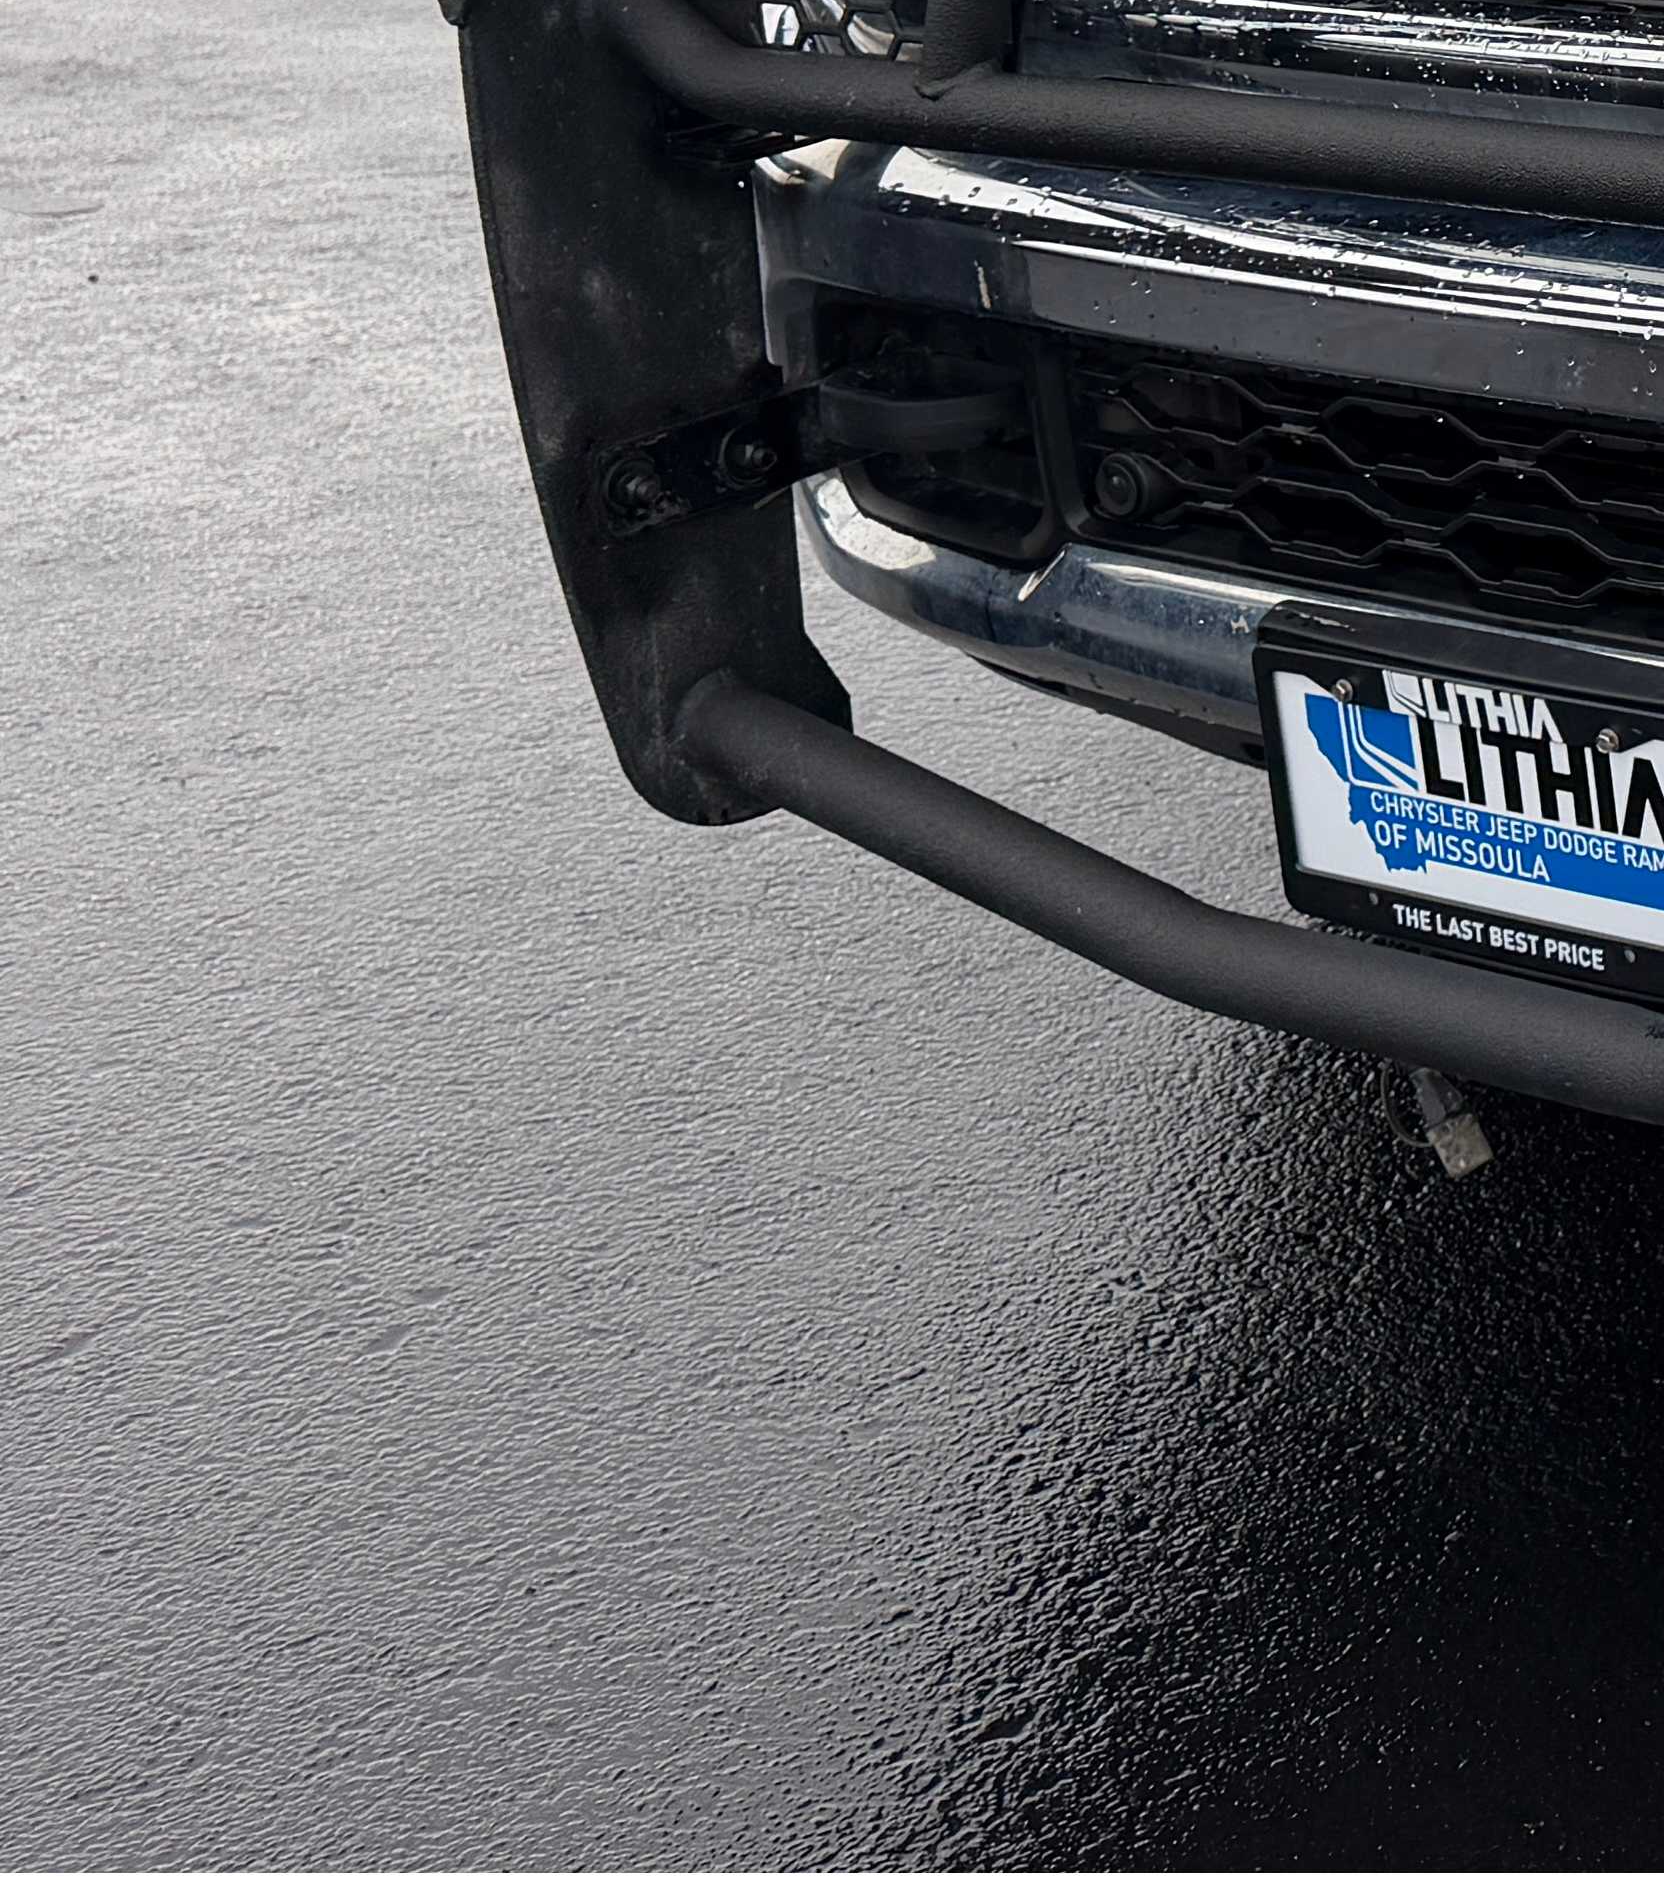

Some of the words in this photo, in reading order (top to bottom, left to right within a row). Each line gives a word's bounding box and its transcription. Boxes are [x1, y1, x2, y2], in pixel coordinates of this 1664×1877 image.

[1421, 677, 1563, 744] LITHIA
[1370, 791, 1480, 835] CHRYSLER
[1486, 815, 1537, 845] JEEP
[1543, 828, 1618, 864] DODGE
[1374, 819, 1409, 850] OF
[1415, 830, 1551, 884] MISSOULA
[1392, 903, 1432, 931] THE
[1435, 913, 1484, 945] LAST
[1488, 925, 1540, 957] BEST
[1543, 938, 1605, 971] PRICE
